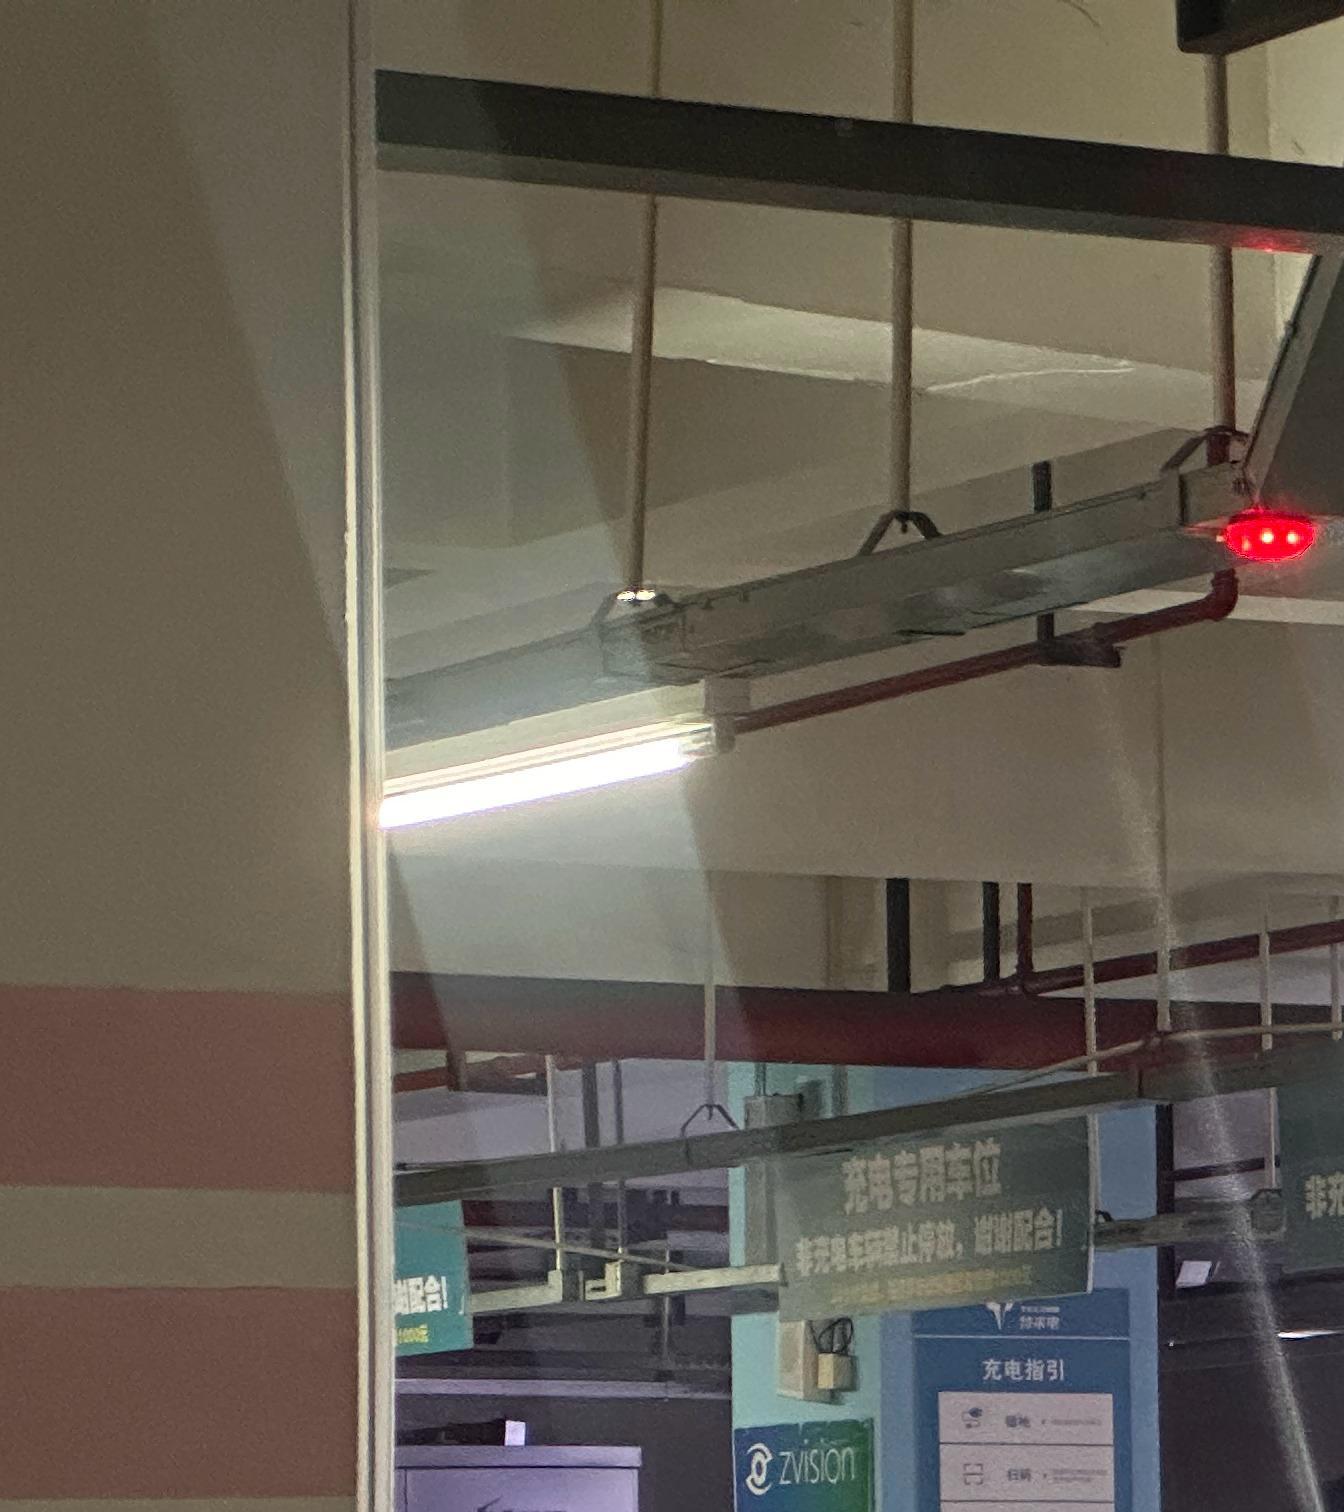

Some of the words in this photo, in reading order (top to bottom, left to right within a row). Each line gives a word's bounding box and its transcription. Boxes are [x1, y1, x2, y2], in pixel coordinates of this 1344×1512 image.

[982, 1358, 1065, 1382] 充电指引
[779, 1439, 855, 1484] zvision
